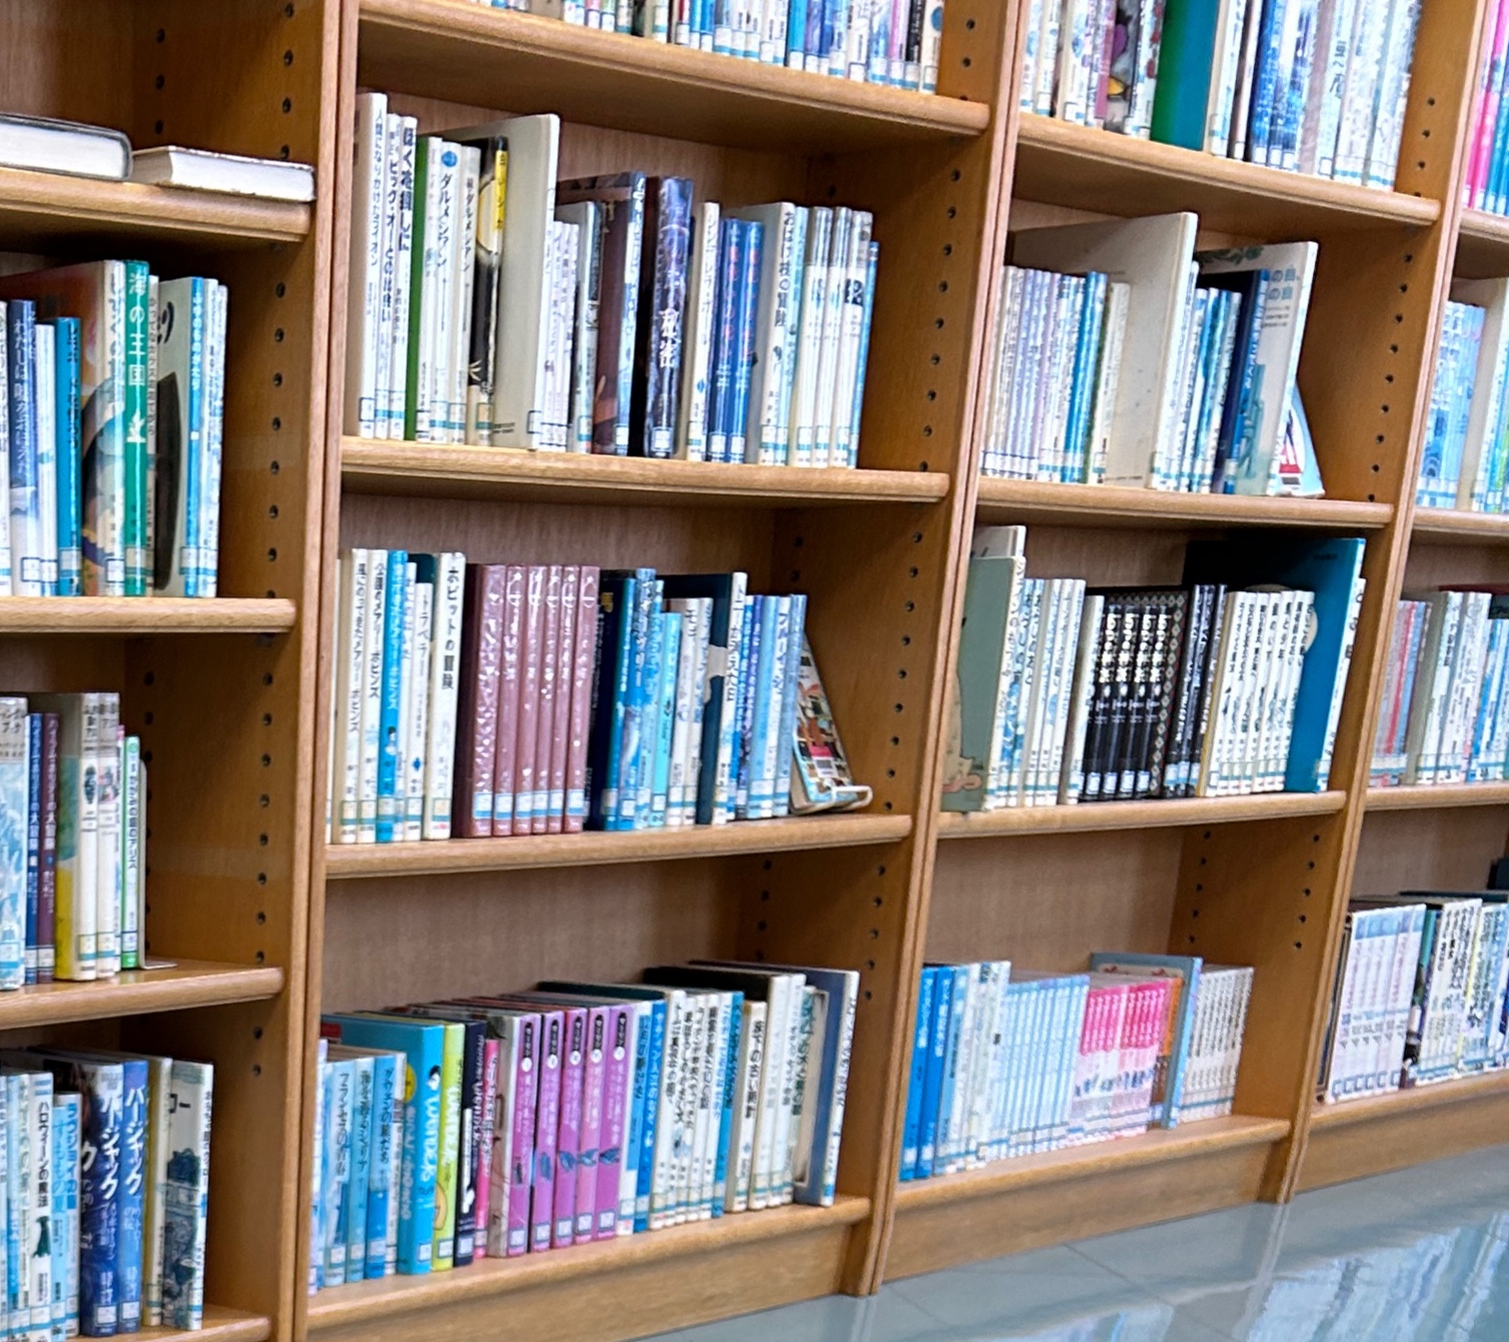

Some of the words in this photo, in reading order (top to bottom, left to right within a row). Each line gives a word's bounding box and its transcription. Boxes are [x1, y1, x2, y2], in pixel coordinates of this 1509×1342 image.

[398, 126, 415, 251] ぼくを探しに
[437, 172, 452, 269] ダルメシアン
[129, 272, 147, 387] 海の王国
[442, 566, 460, 690] ホビットの冒険
[125, 1086, 146, 1196] バージャック
